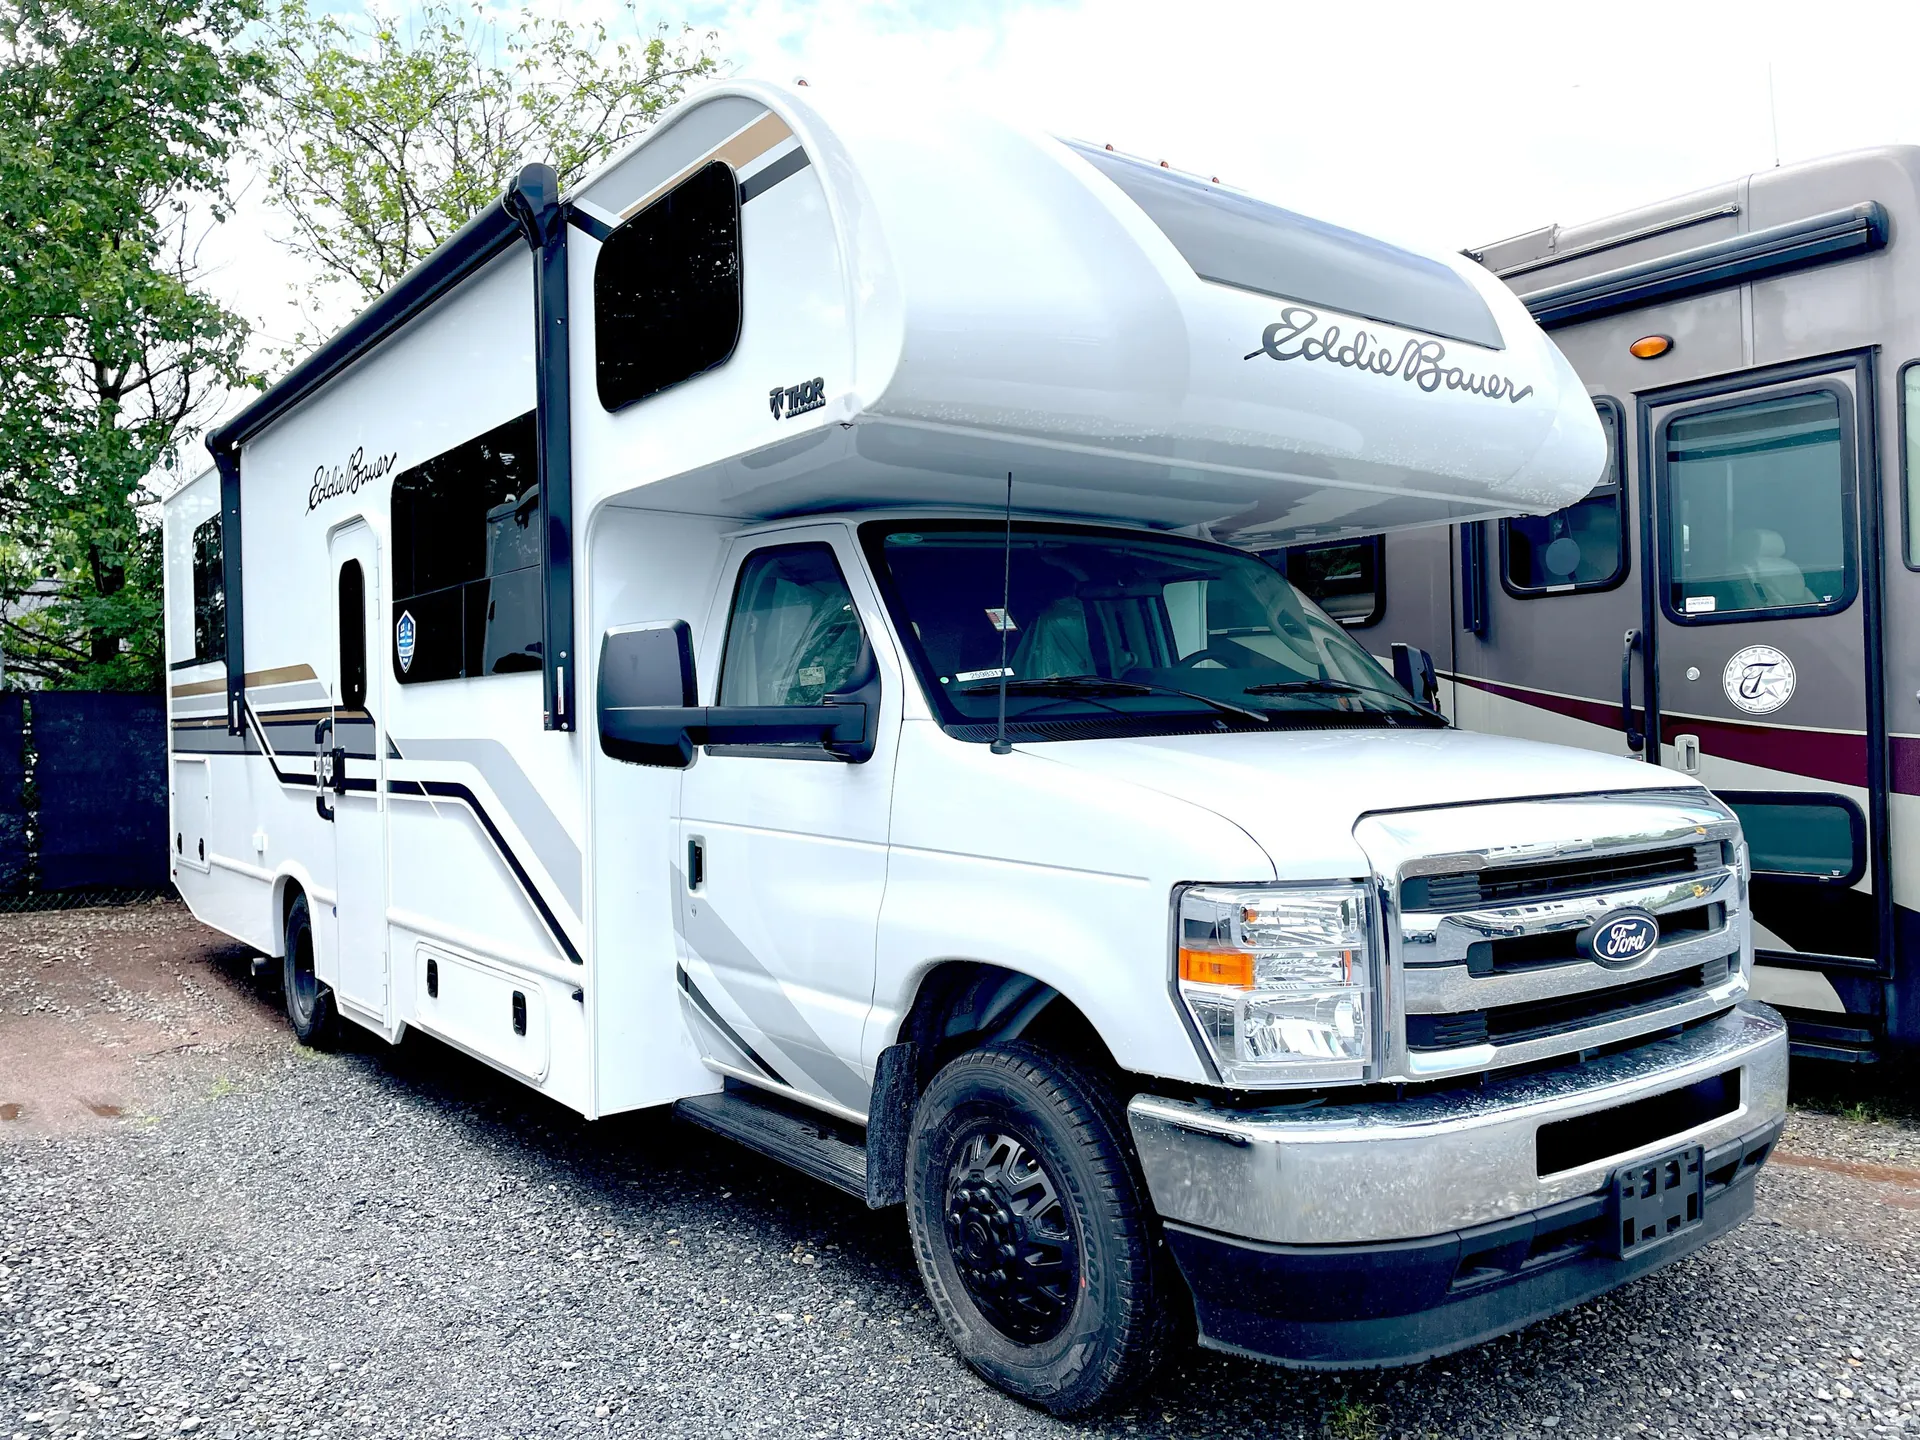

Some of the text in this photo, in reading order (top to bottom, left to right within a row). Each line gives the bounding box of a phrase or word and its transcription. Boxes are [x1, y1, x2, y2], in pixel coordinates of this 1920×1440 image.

[1244, 307, 1533, 403] Eddie Bauer
[785, 376, 825, 410] THOR
[305, 446, 397, 516] Eddie Bauer
[1607, 923, 1646, 955] Ford
